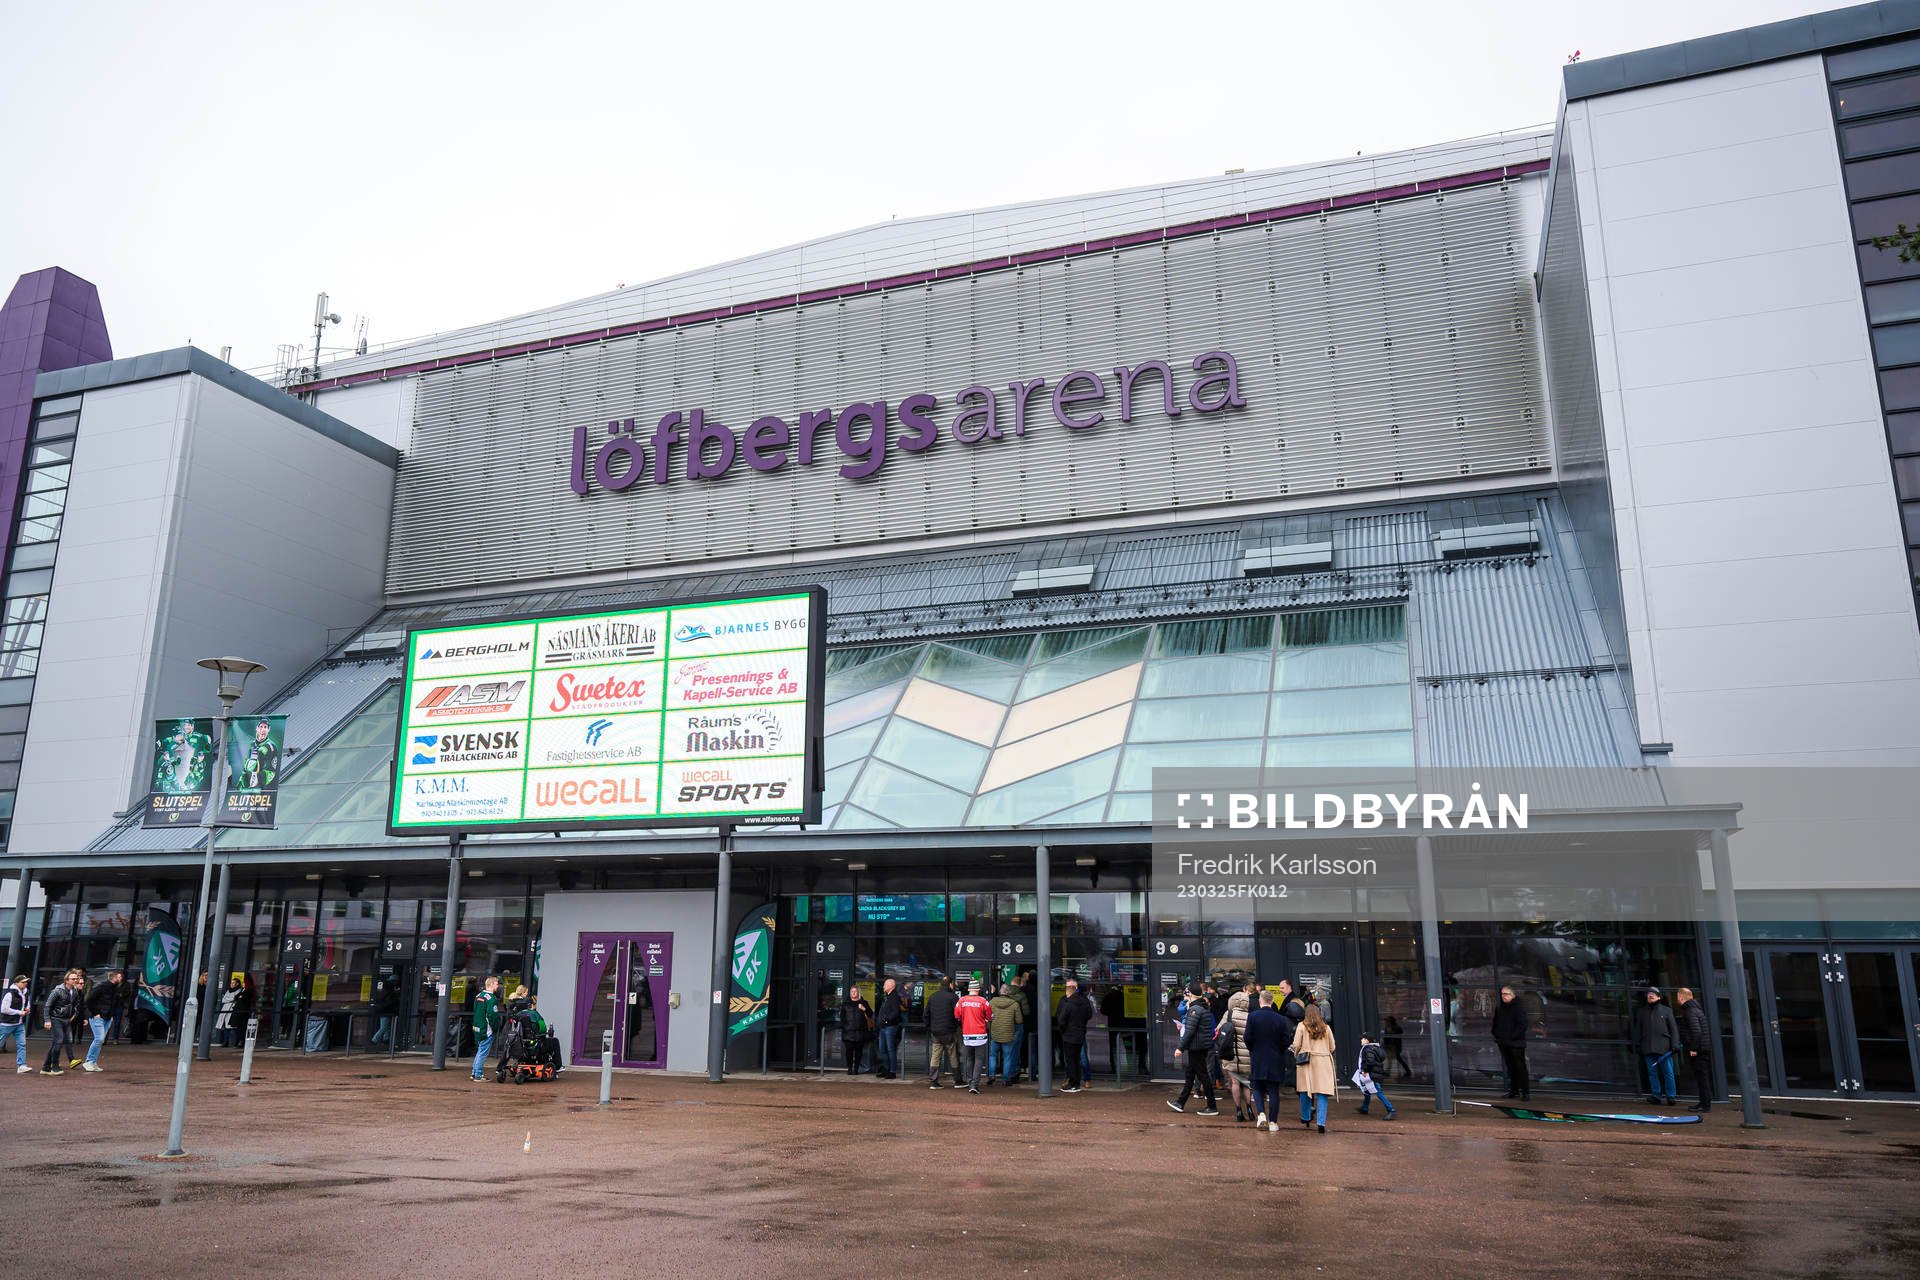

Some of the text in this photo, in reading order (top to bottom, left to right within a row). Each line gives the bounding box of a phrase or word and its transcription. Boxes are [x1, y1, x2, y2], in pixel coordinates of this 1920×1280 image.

[715, 618, 806, 635] BJARNES BYGG
[548, 619, 656, 652] NÄSMANS ÅKERI AB
[445, 642, 530, 658] BERGHOLM
[572, 648, 625, 661] GRÄSMARK
[692, 671, 773, 686] Presennings
[778, 668, 789, 680] &
[443, 680, 527, 706] ASM
[549, 673, 646, 712] Swetex
[683, 682, 798, 702] Kapell-Service AB
[440, 731, 519, 752] SVENSK
[686, 729, 764, 752] Maskin
[440, 751, 518, 762] TRÄLACKERING AB
[547, 746, 642, 763] Fastighetsservice AB
[416, 777, 469, 794] K.M.M.
[678, 781, 788, 804] SPORTS
[153, 796, 203, 808] SLUTSPEL
[228, 795, 272, 806] SLUTSPEL
[745, 816, 800, 824] www.alfaneon.se
[287, 940, 293, 950] 2
[387, 940, 393, 951] 3
[421, 941, 428, 951] 4
[816, 941, 824, 953] 6
[955, 942, 963, 954] 7
[1002, 942, 1011, 954] 8
[1156, 942, 1165, 955] 9
[1304, 942, 1322, 955] 10
